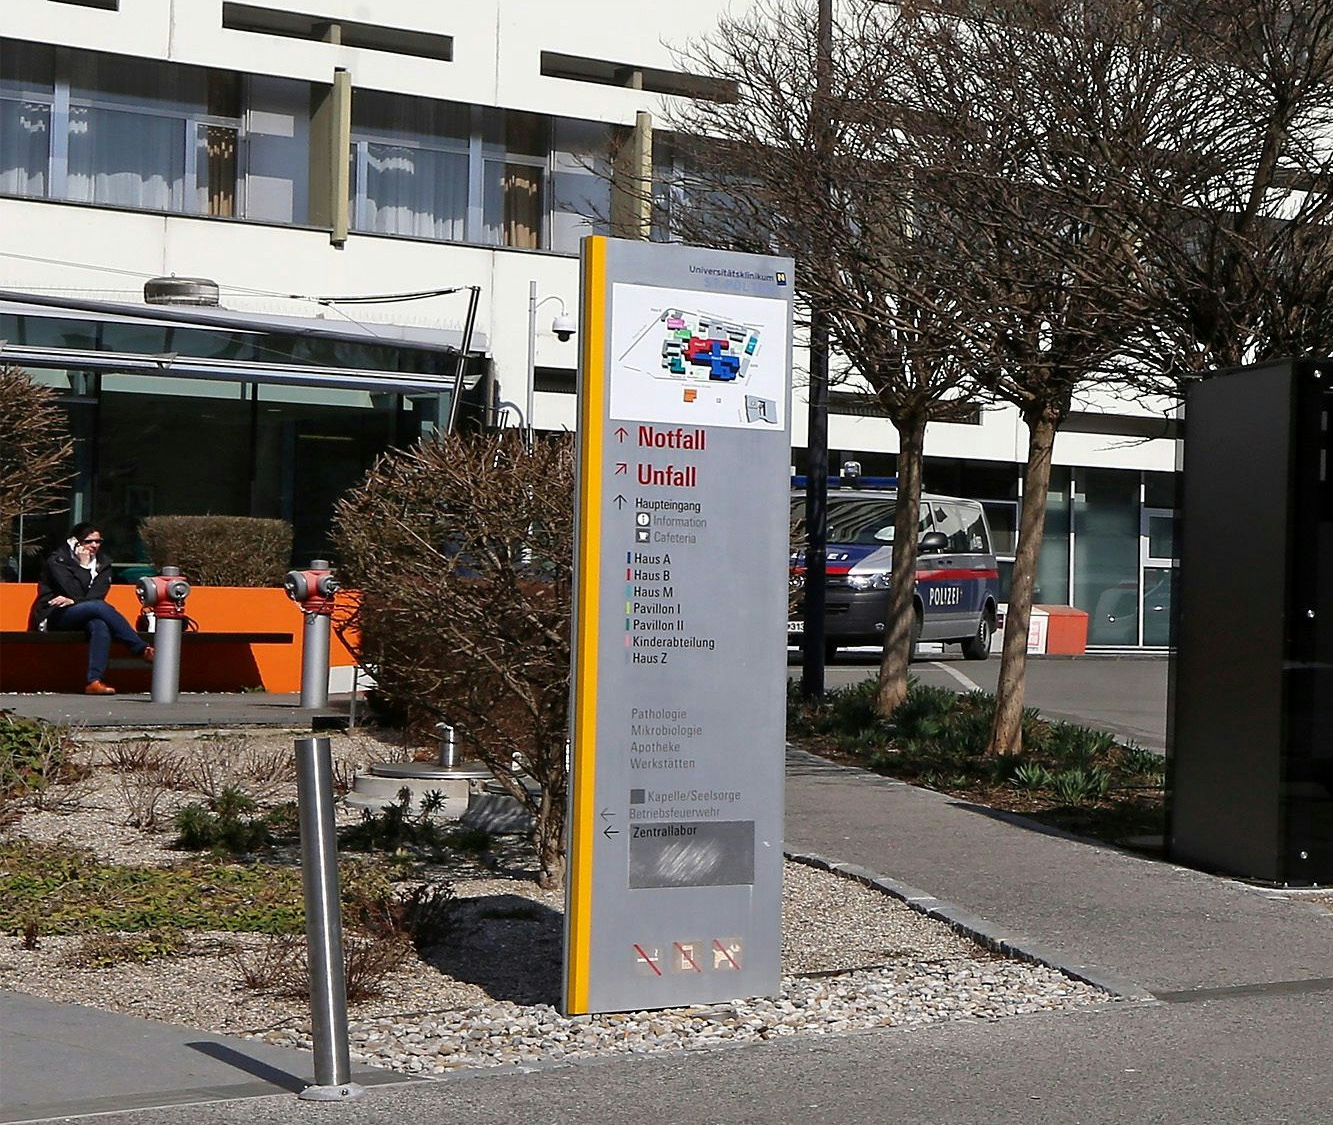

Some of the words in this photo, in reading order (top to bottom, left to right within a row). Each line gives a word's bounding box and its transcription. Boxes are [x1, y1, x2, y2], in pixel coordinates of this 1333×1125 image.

[638, 425, 706, 451] Notfall
[637, 463, 697, 488] Unfall
[635, 497, 702, 515] Haupteingang
[653, 515, 708, 528] Information
[653, 531, 697, 544] Cafeteria
[634, 552, 661, 565] Haus
[663, 553, 671, 565] A
[634, 569, 661, 582] Haus
[663, 570, 671, 582] B
[633, 585, 660, 598] Haus
[662, 586, 673, 598] M
[929, 587, 960, 606] POLIZEI
[633, 602, 675, 615] Pavillon
[633, 619, 675, 631] Pavillon
[677, 620, 684, 631] II
[632, 635, 715, 651] Kinderabteilung
[632, 652, 659, 664] Haus
[661, 652, 668, 664] Z
[631, 707, 687, 722] Pathologie
[630, 724, 703, 738] Mikrobiologie
[630, 741, 681, 755] Apotheke
[630, 757, 696, 770] Werkstätten
[647, 790, 742, 804] Kapelle/Seelsorge
[629, 806, 721, 820] Betriebsfeuerwehr
[632, 824, 698, 839] Zentrallabor
